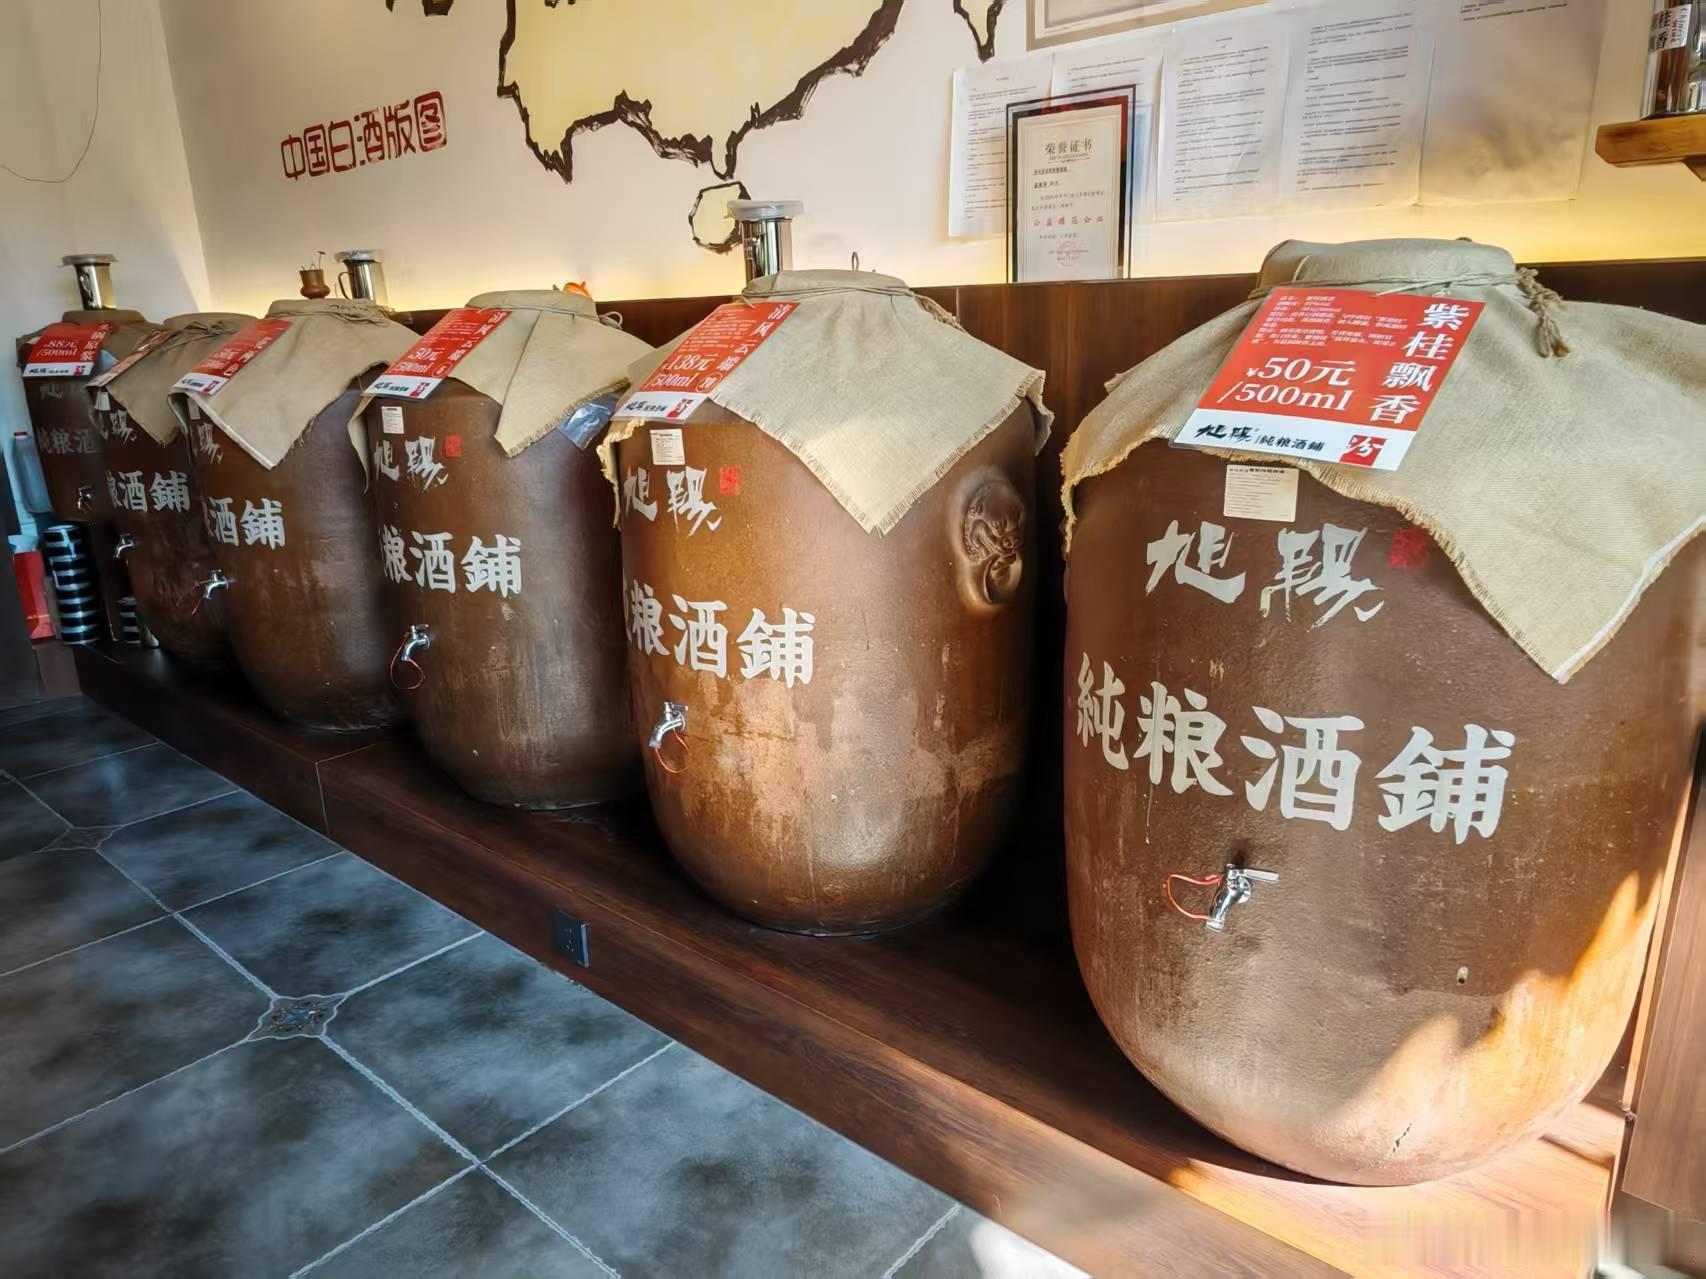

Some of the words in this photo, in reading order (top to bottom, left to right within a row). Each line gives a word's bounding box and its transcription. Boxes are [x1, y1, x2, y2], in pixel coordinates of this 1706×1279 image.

[1217, 381, 1354, 411] /500ml
[1246, 357, 1356, 386] ¥50元
[1368, 302, 1470, 426] 紫桂飘香
[201, 497, 286, 550] 酒鋪
[379, 523, 522, 599] 粮酒鋪
[623, 568, 816, 688] 粮酒鋪
